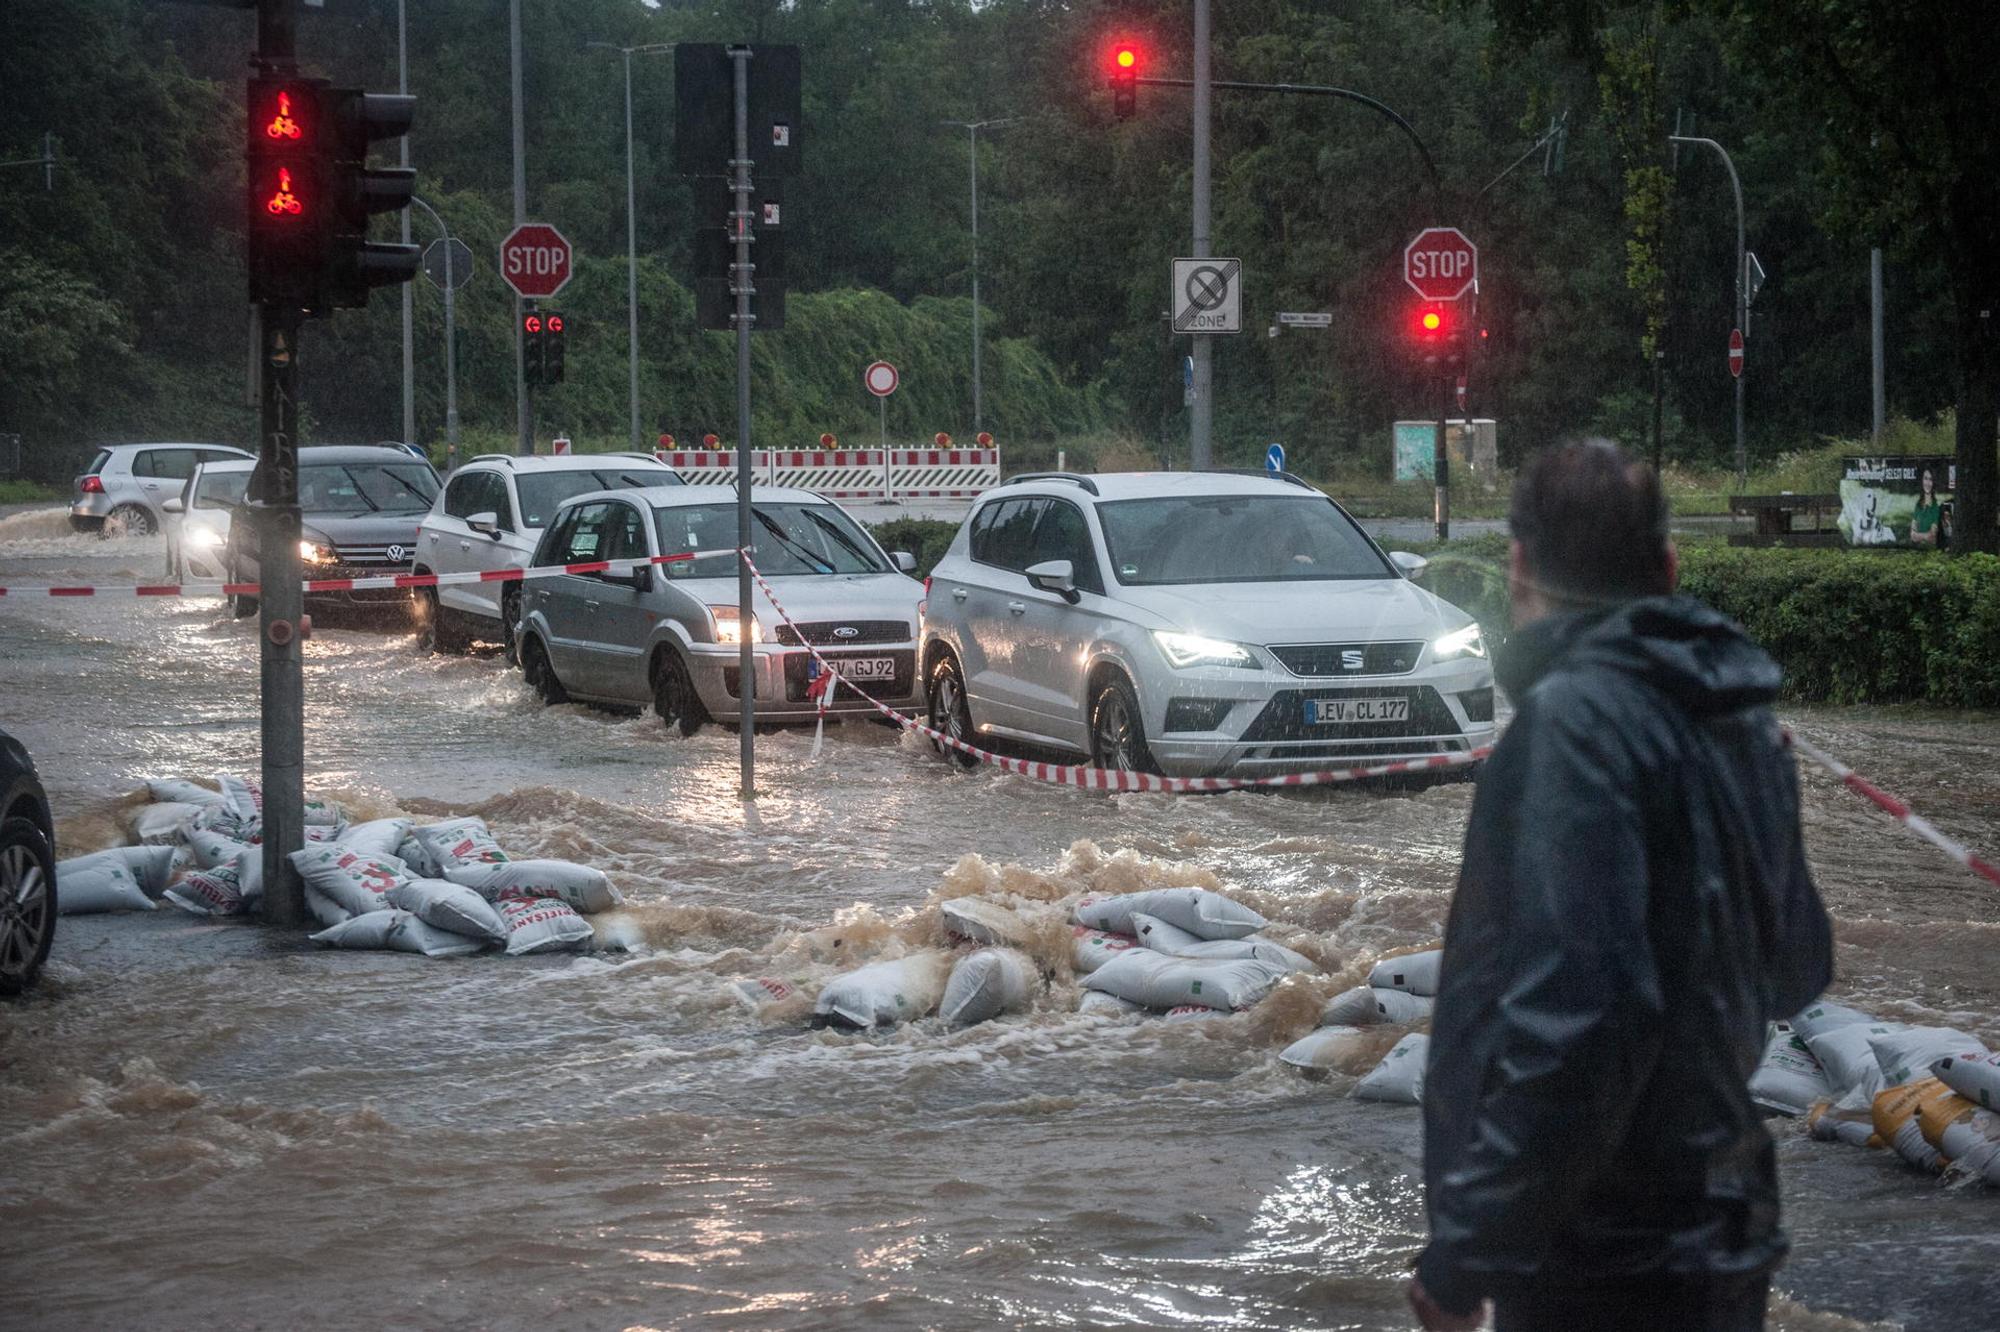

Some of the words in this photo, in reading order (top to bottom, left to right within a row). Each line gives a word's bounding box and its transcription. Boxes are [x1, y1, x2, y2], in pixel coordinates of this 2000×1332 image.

[508, 246, 565, 275] STOP
[1412, 250, 1470, 278] STOP
[1190, 315, 1225, 328] ZONE
[875, 660, 893, 676] 92
[1316, 702, 1345, 721] LEV
[1356, 702, 1376, 720] CL
[1379, 700, 1407, 719] 177
